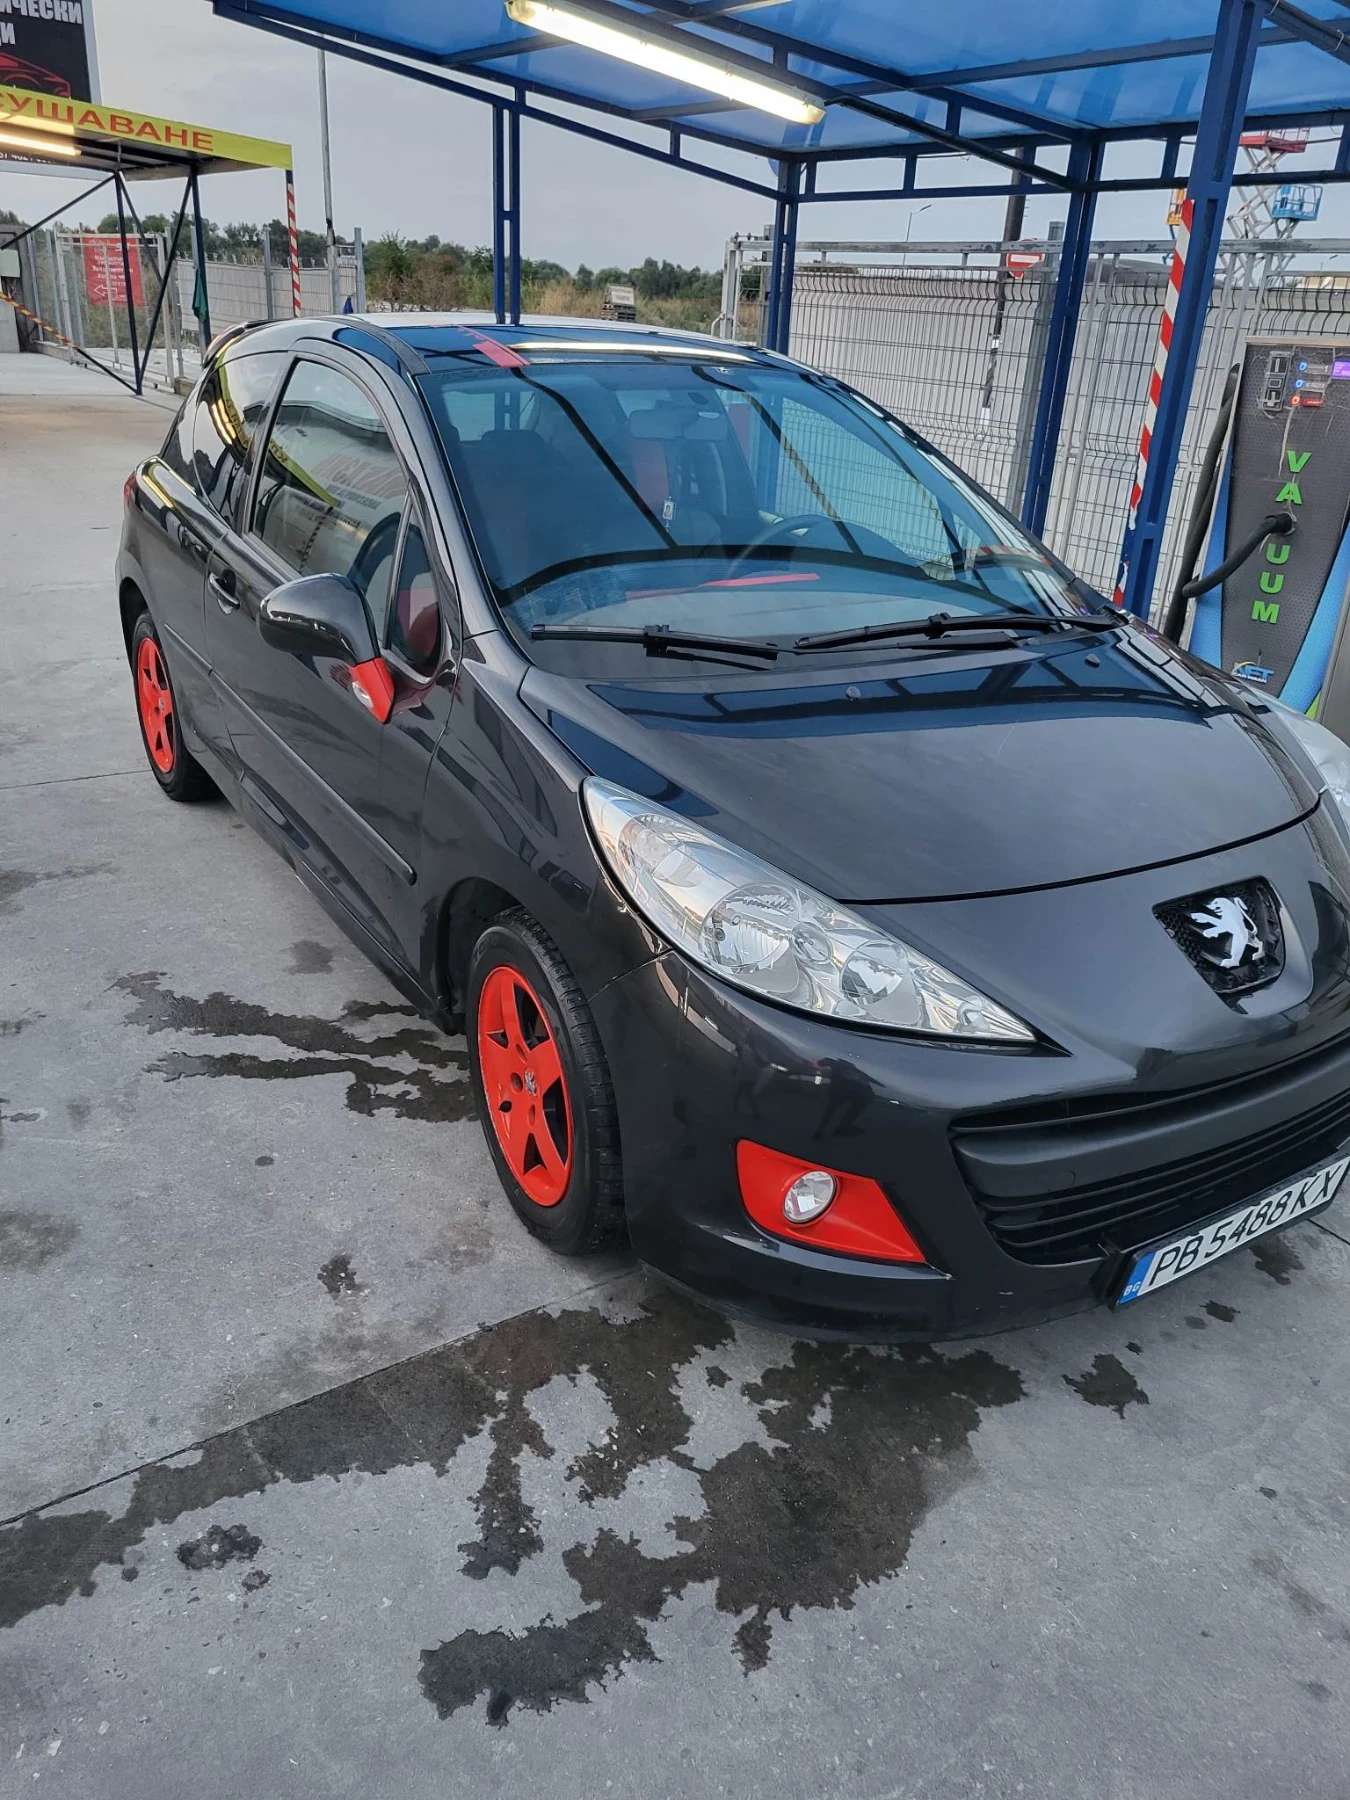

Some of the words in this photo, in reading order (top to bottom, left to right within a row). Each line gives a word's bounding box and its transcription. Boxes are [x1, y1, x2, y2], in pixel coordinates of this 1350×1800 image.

[1251, 450, 1312, 624] VAUUM
[1203, 1190, 1293, 1258] 5488
[1123, 1281, 1141, 1297] BG
